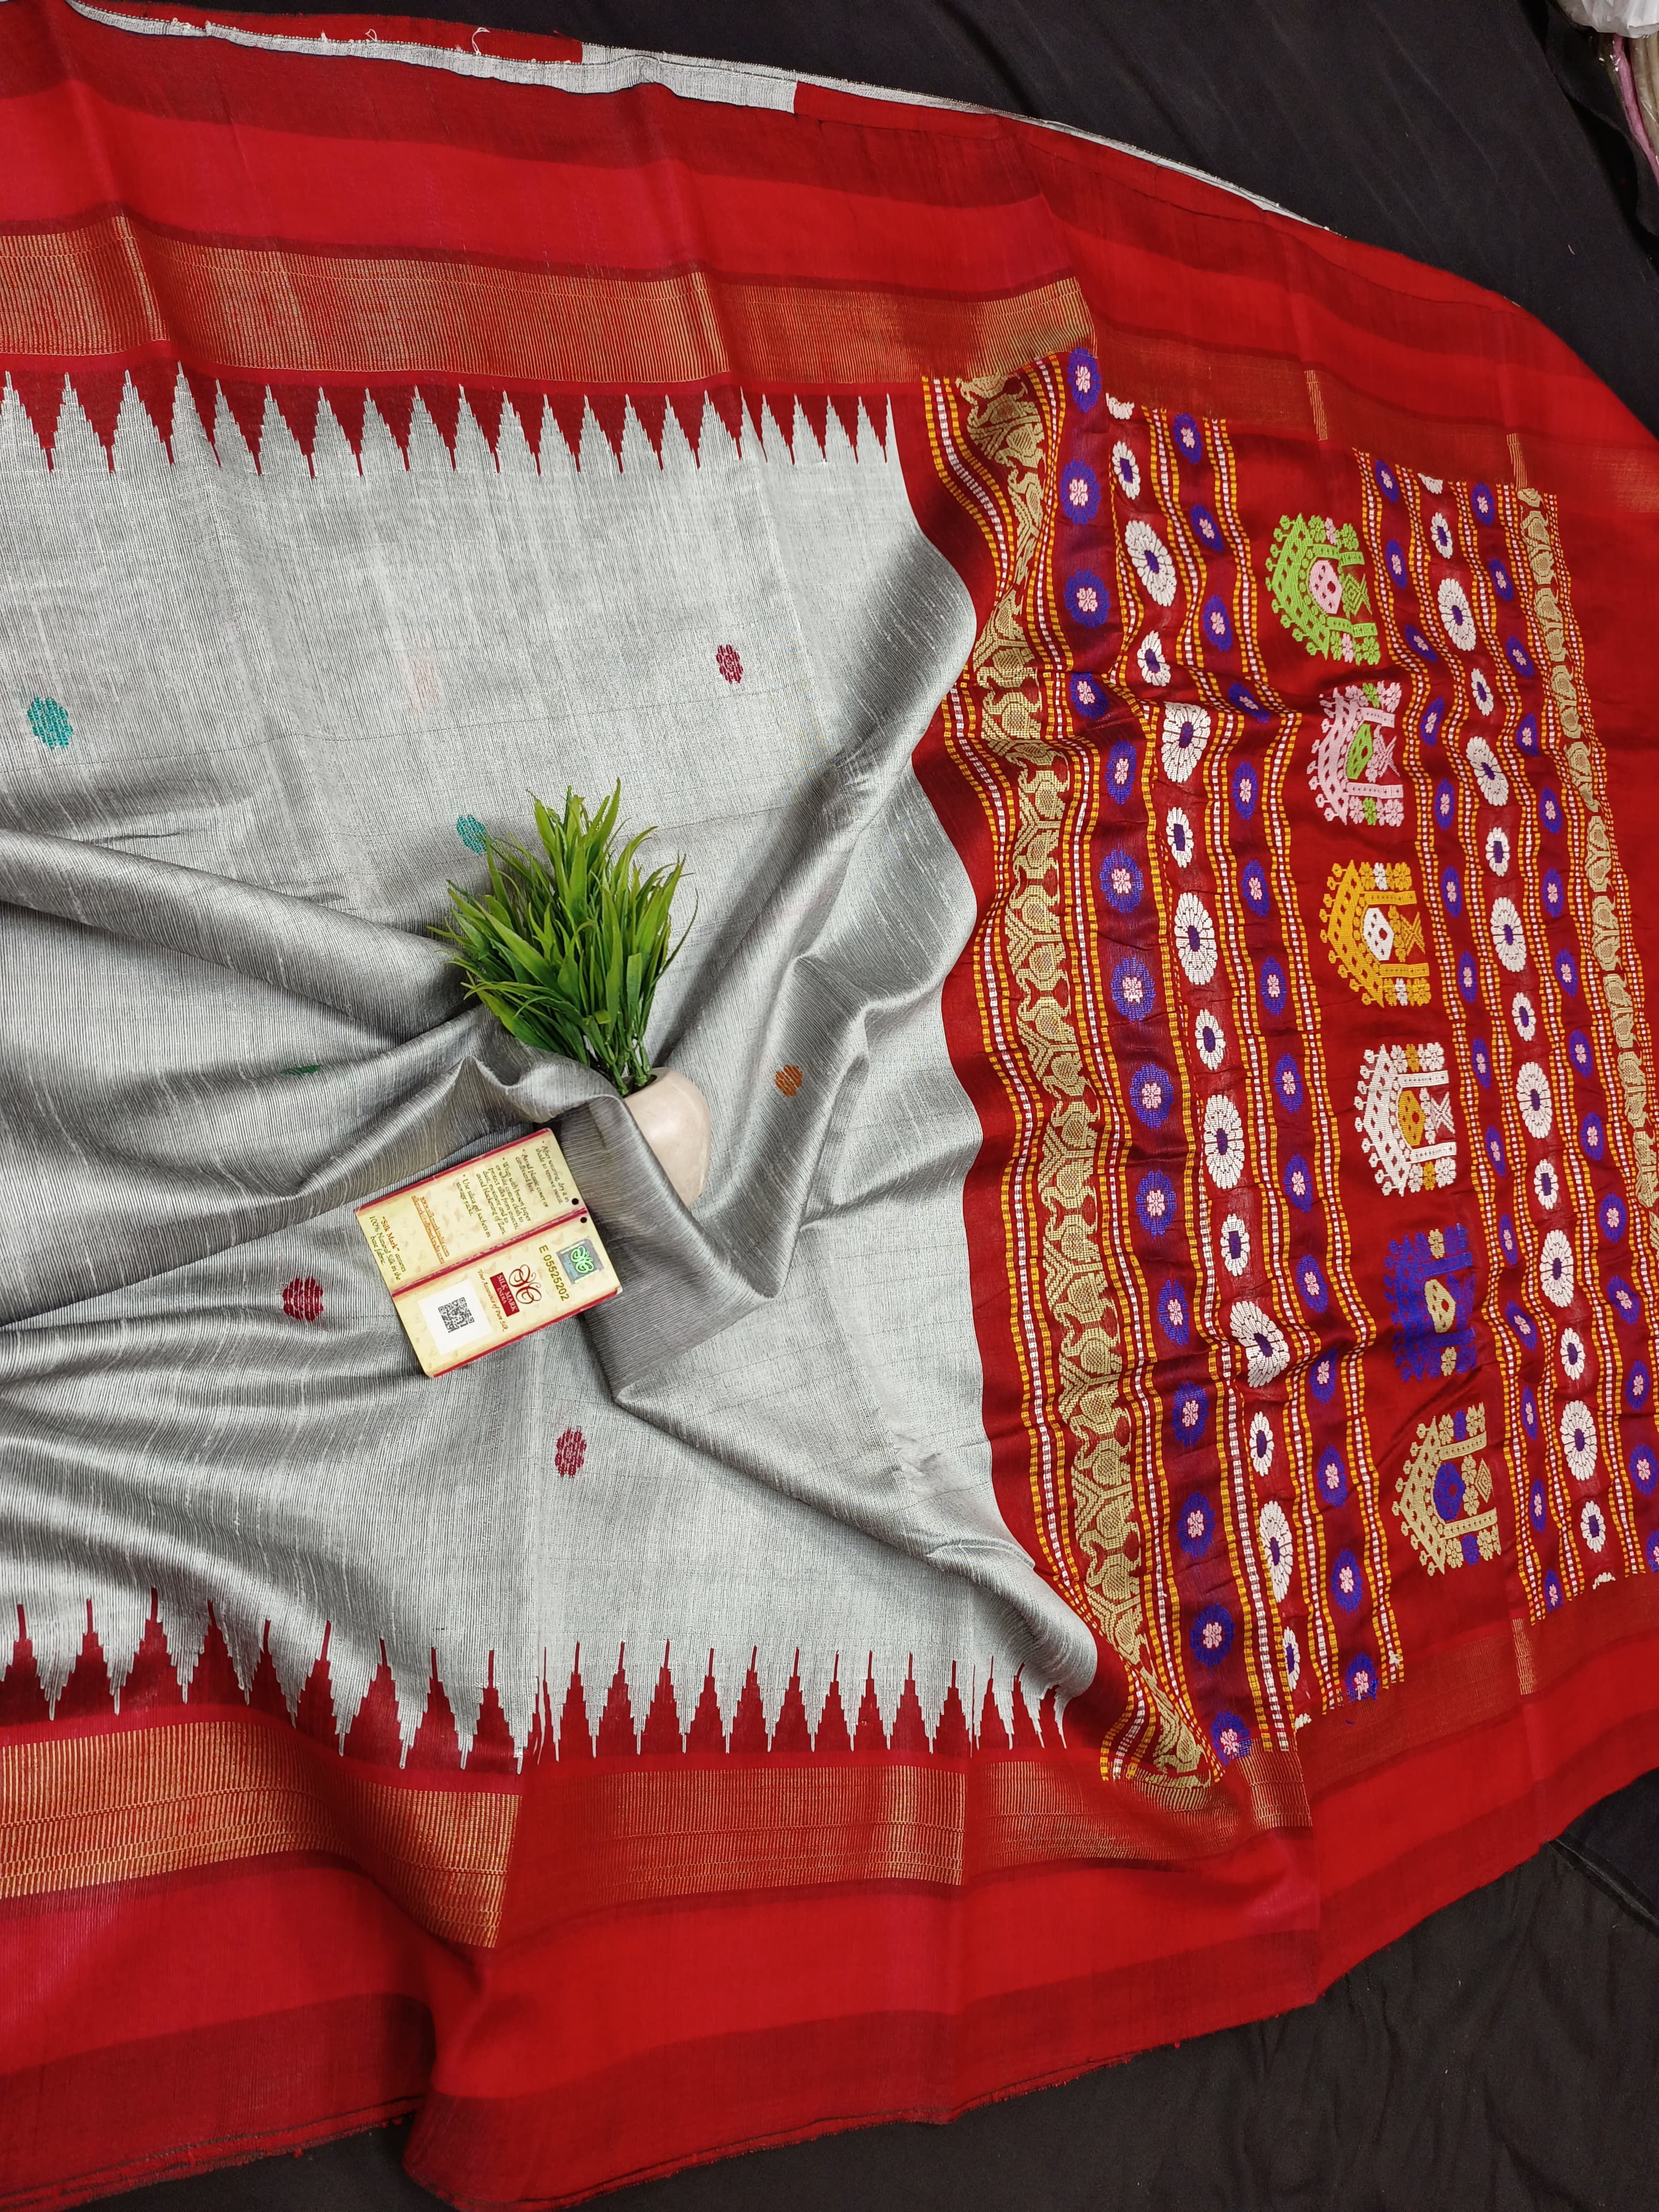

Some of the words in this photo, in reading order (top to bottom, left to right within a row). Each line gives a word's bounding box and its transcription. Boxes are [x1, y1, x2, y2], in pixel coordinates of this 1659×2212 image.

[462, 1178, 471, 1190] Use
[369, 1215, 381, 1232] 100%
[386, 1254, 395, 1265] Silk
[394, 1271, 402, 1280] the
[538, 1244, 548, 1253] E
[543, 1254, 569, 1301] 05525202
[496, 1287, 507, 1304] INDIA
[497, 1274, 508, 1290] SILK
[504, 1291, 517, 1312] MARK
